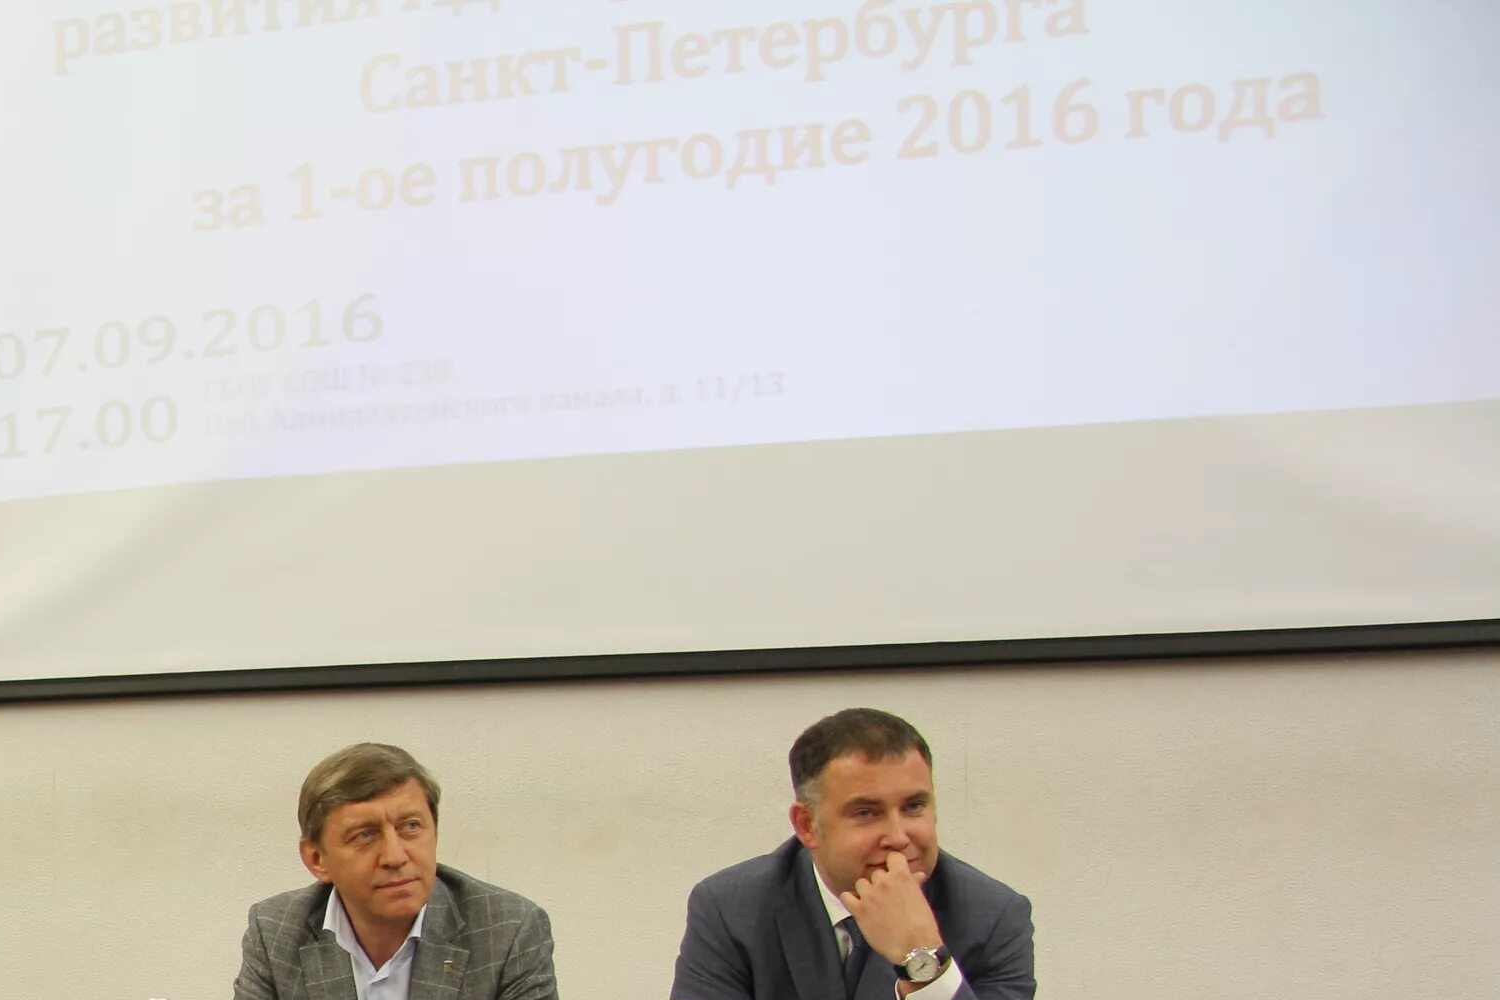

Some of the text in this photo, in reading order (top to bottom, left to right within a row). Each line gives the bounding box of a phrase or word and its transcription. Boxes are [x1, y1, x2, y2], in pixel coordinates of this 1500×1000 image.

[359, 0, 1090, 113] Санкт-Петербурга
[190, 69, 1326, 232] за 1-ое полугодие 2016 года
